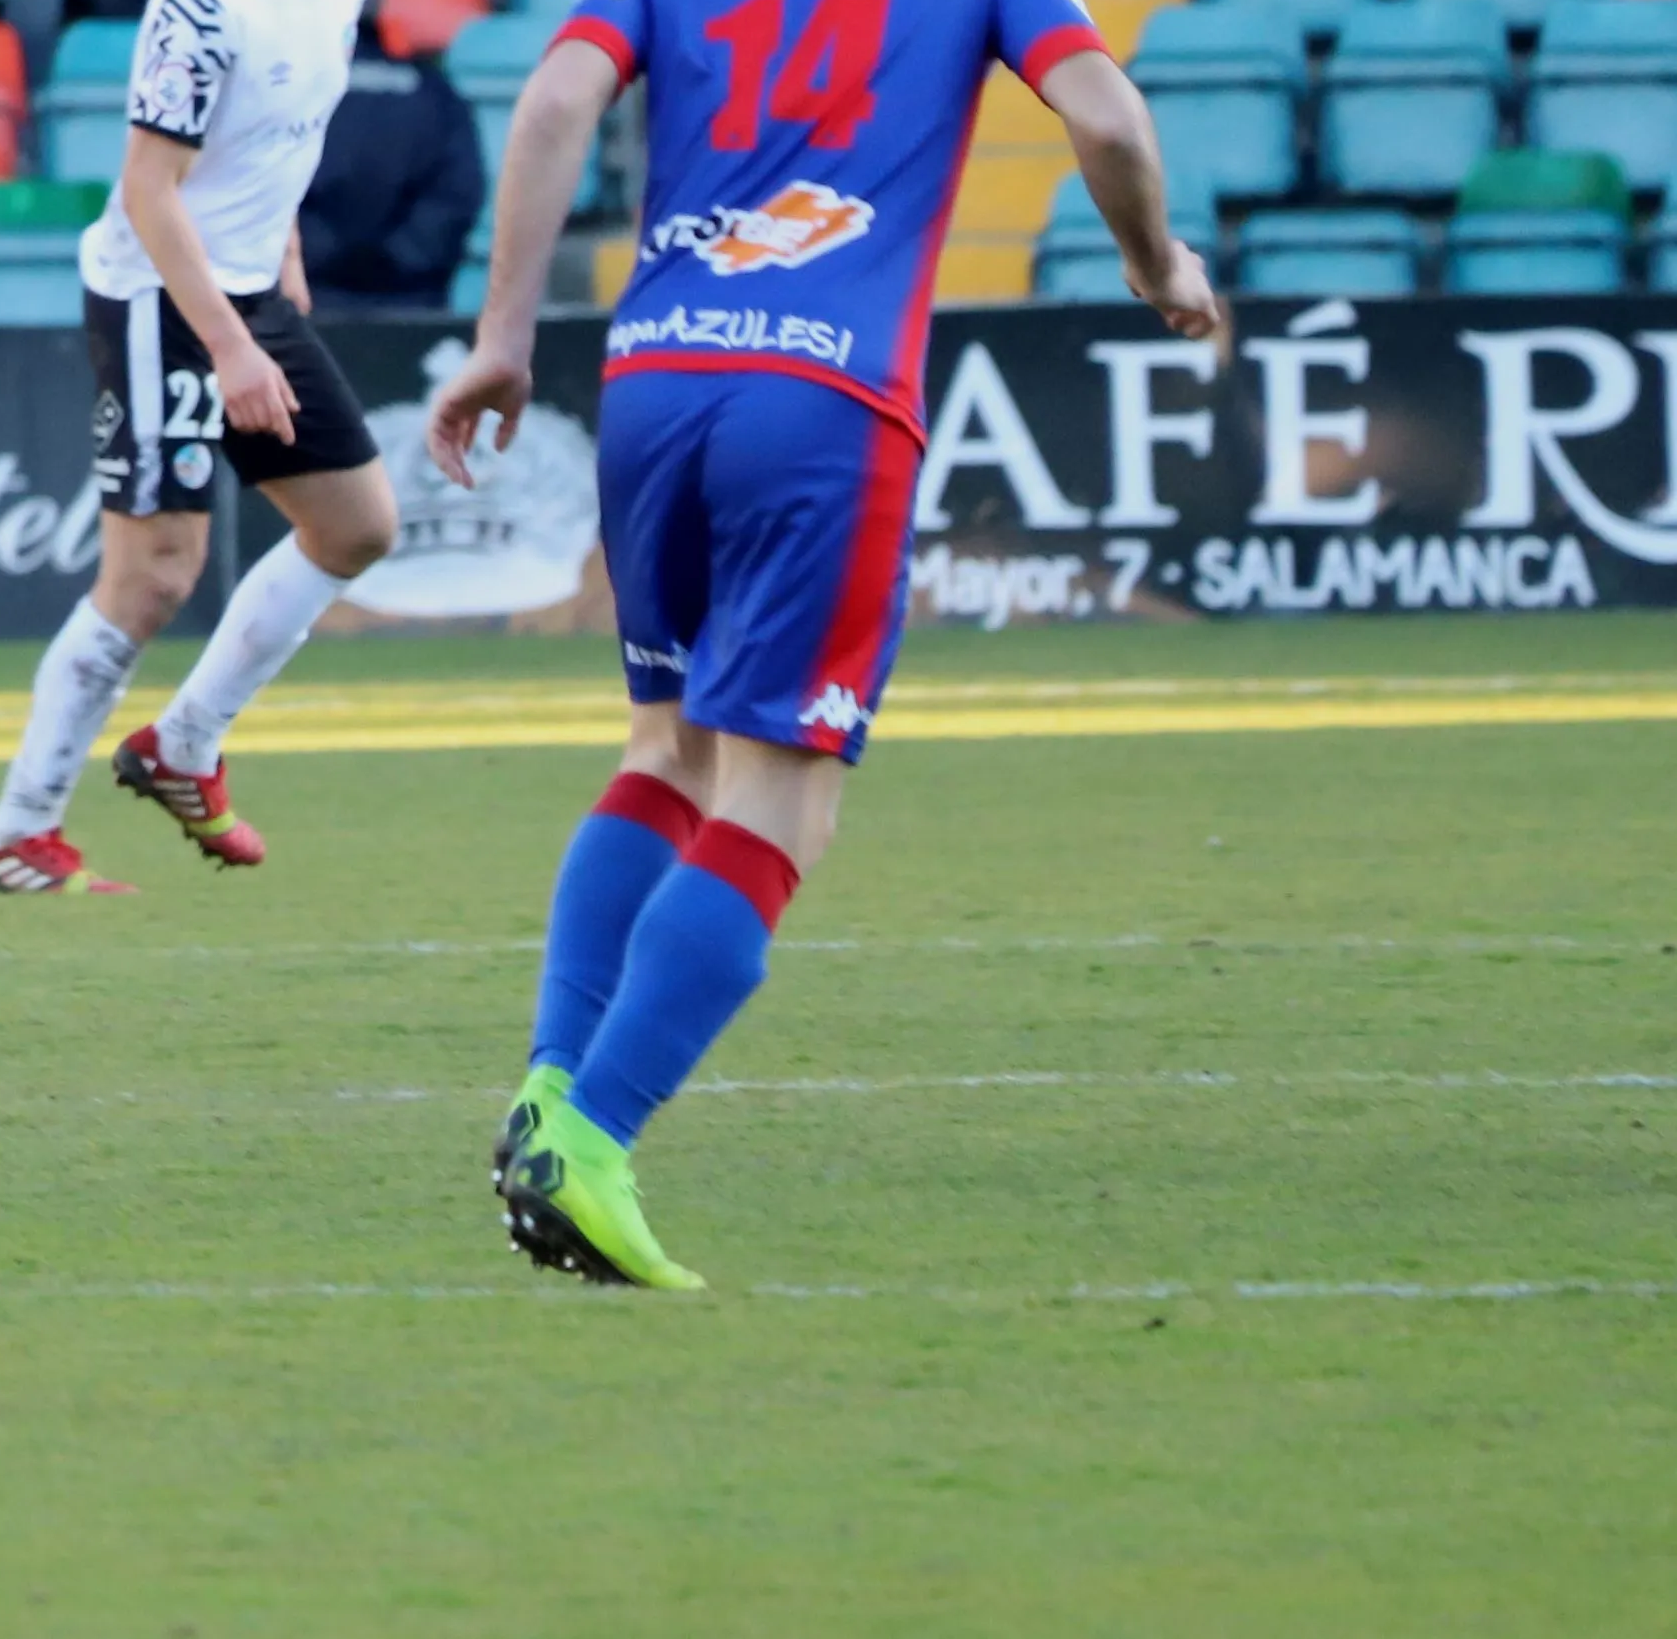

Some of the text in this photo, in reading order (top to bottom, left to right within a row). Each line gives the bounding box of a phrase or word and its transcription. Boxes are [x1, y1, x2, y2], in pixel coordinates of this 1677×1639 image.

[915, 299, 1381, 530] AFÉ
[1102, 539, 1151, 612] 7
[1194, 534, 1597, 610] SALAMANCA
